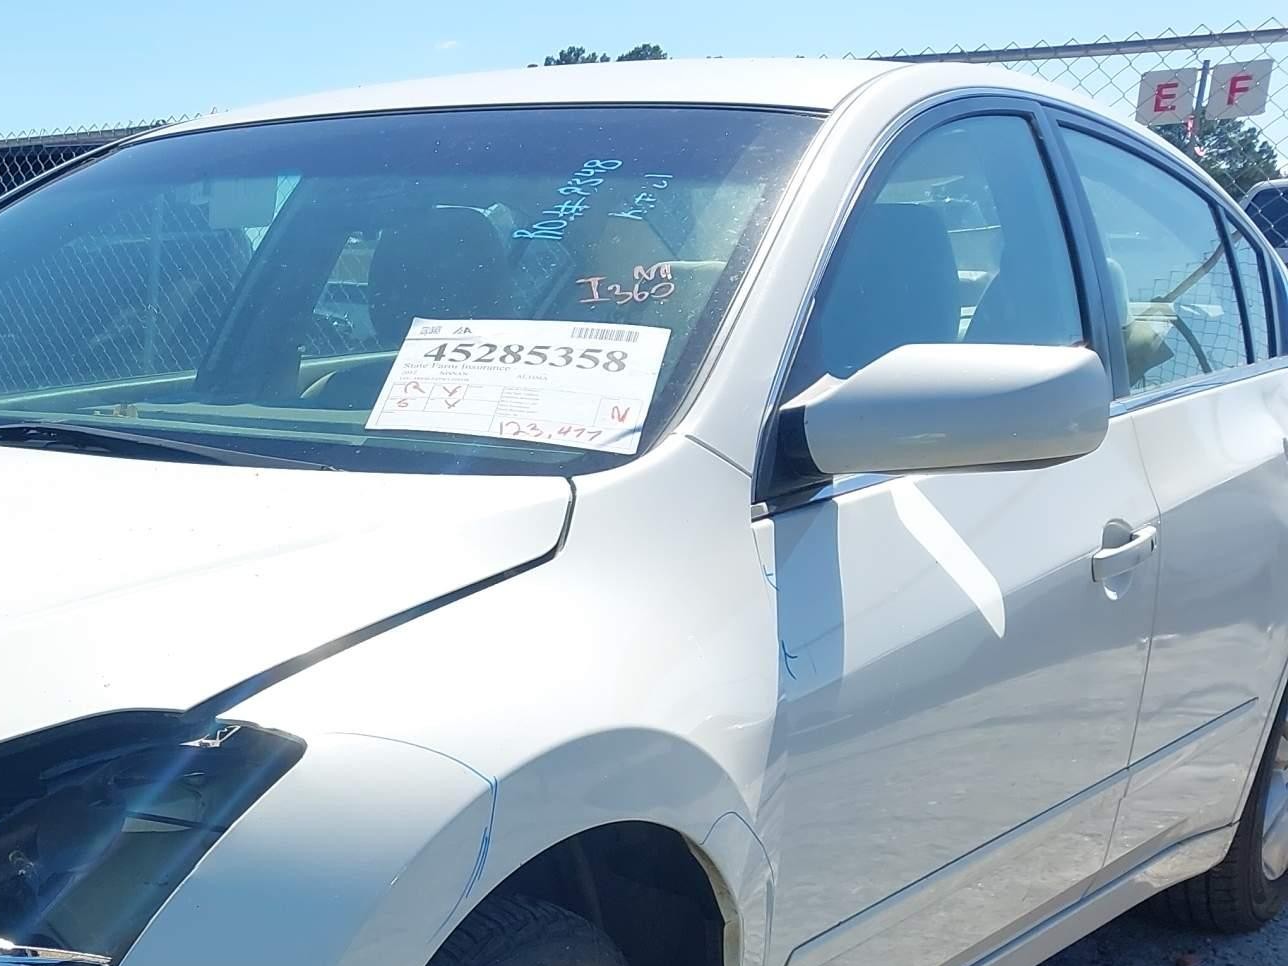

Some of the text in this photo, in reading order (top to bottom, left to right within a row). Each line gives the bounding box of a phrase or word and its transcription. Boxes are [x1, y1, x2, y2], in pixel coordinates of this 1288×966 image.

[1153, 82, 1179, 112] E
[1226, 74, 1253, 106] F
[423, 342, 629, 373] 45285358
[432, 362, 458, 370] Farm
[461, 363, 512, 372] Insurance
